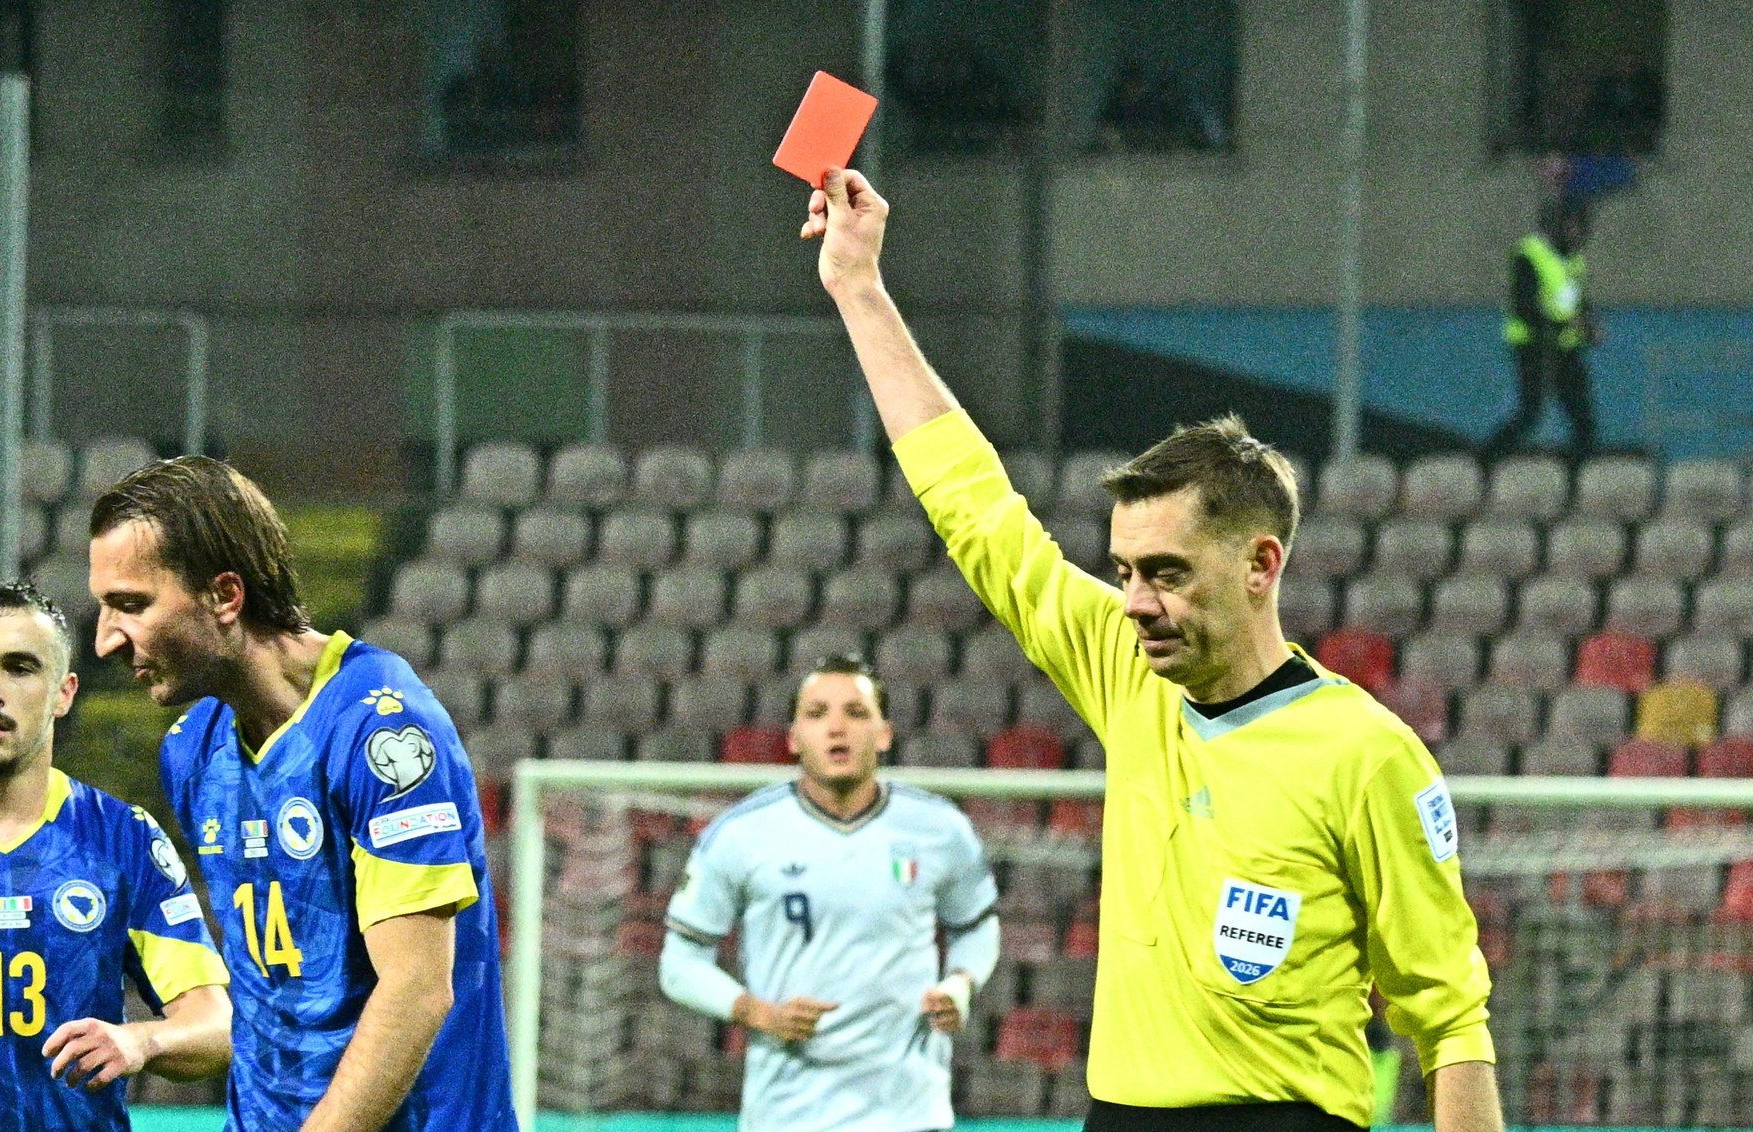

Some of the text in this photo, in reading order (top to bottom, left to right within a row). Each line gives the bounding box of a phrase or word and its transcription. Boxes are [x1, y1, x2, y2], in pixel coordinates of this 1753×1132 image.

[783, 893, 814, 946] 9
[1226, 886, 1290, 922] FIFA
[232, 880, 303, 978] 14
[1220, 924, 1285, 950] REFEREE
[1230, 960, 1261, 977] 2026
